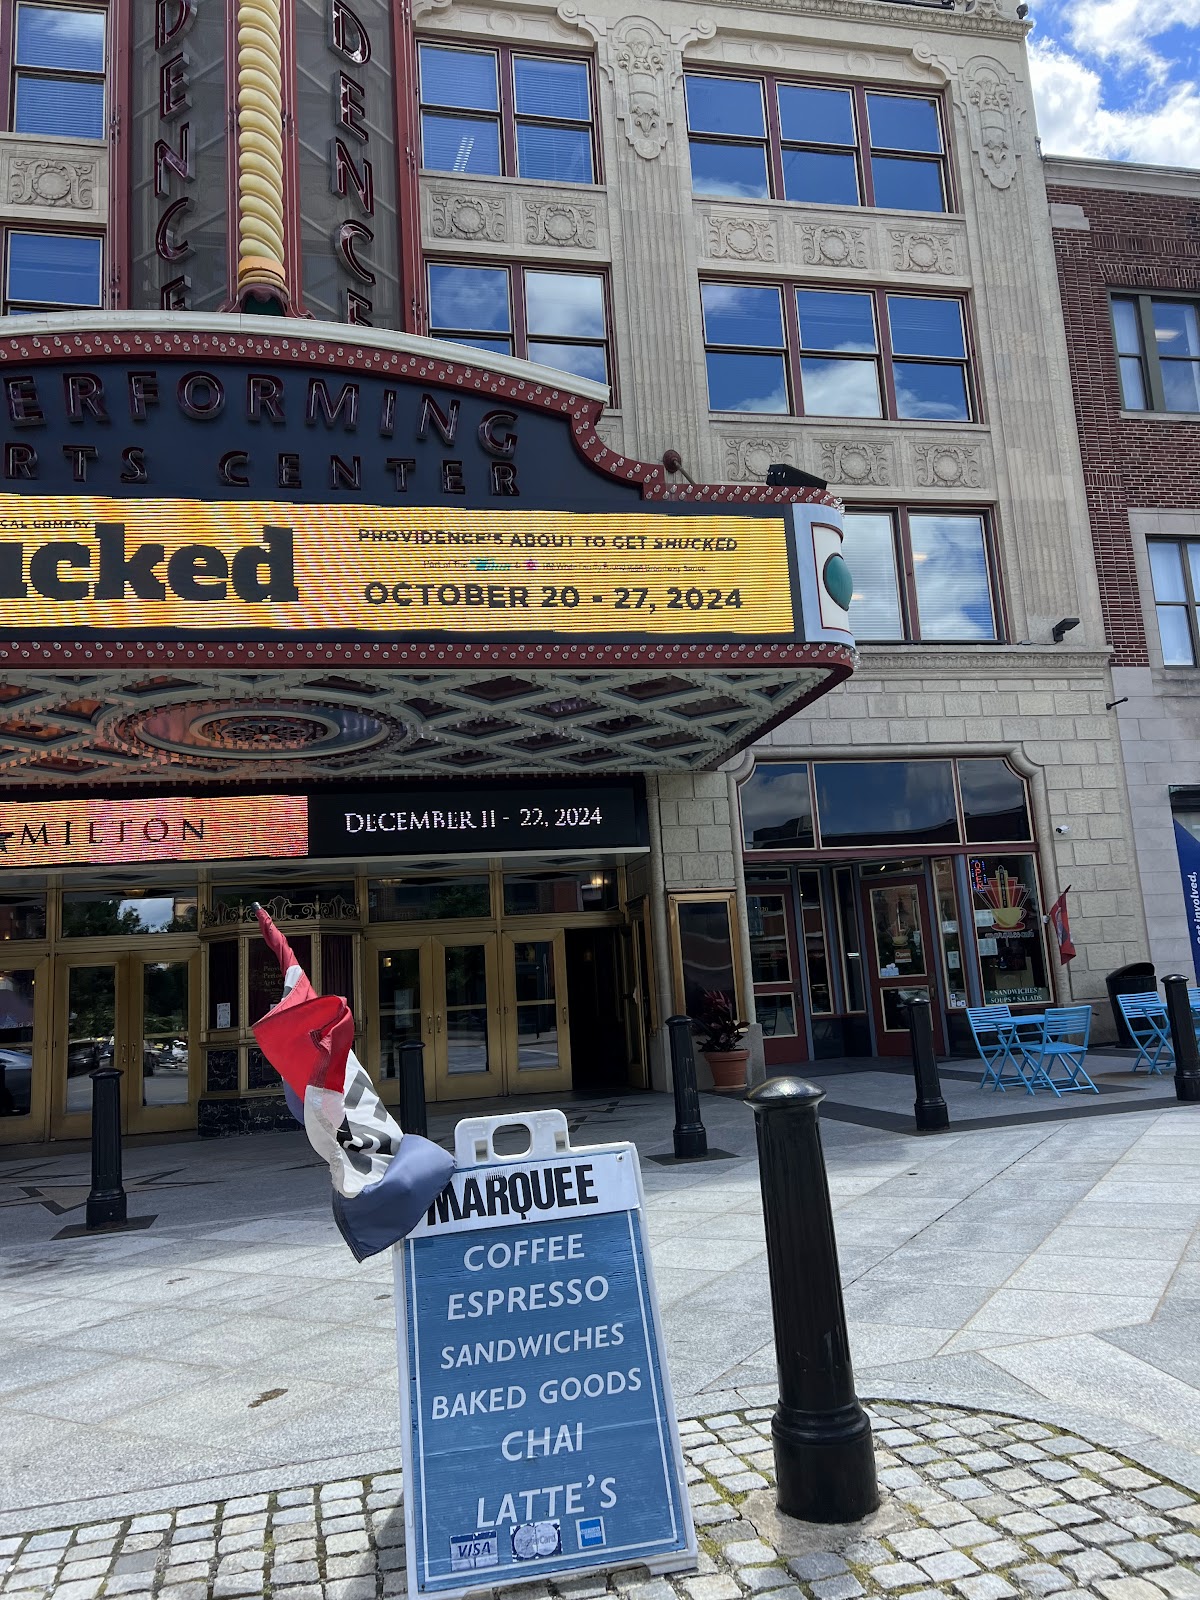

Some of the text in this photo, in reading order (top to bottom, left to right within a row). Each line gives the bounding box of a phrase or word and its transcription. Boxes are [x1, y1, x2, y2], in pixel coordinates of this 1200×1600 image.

[3, 371, 519, 458] ERFORMING
[4, 442, 520, 497] RTS CENTER
[359, 529, 738, 552] PROVIDENCE'S ABOUT TO GET SHUCKED
[365, 581, 529, 608] OCTOBER
[542, 585, 580, 608] 20
[614, 587, 656, 615] 27,
[666, 586, 743, 611] 2024
[20, 817, 205, 846] MILTON
[344, 809, 478, 833] DECEMBER
[519, 807, 549, 828] 22,
[555, 806, 603, 827] 2024
[1187, 871, 1200, 923] involved,
[990, 994, 1043, 1004] SOUPS SALADS
[994, 987, 1038, 996] SANDWICHES
[427, 1164, 599, 1225] MARQUEE
[463, 1233, 585, 1272] COFFEE
[447, 1275, 609, 1321] ESPRESSO
[440, 1323, 625, 1370] SANDWICHES
[431, 1367, 642, 1420] BAKED GOODS
[501, 1421, 583, 1462] CHAI
[476, 1474, 617, 1529] LATTE'S
[458, 1541, 491, 1558] VISA
